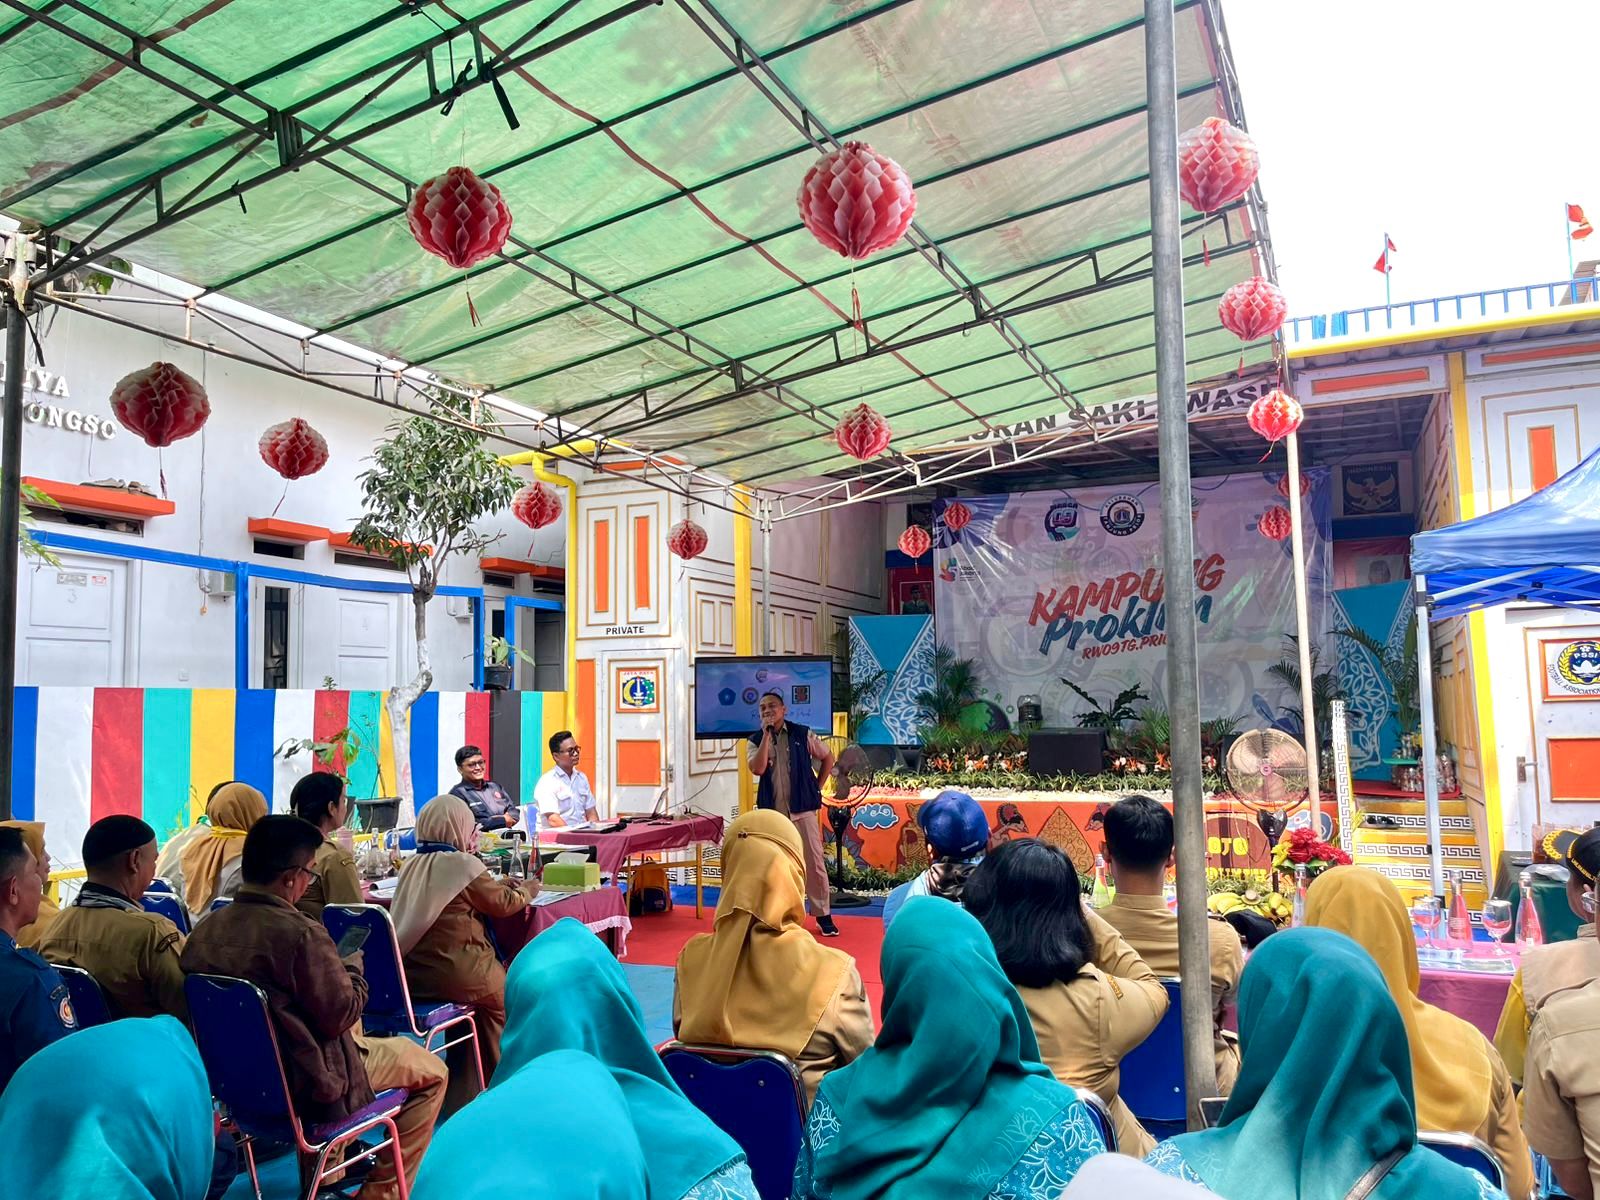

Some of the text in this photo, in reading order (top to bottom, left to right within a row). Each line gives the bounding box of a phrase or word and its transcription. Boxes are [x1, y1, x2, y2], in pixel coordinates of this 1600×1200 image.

[605, 626, 645, 636] PRIVATE
[1573, 652, 1598, 660] PSSI
[1207, 836, 1250, 857] OJO
